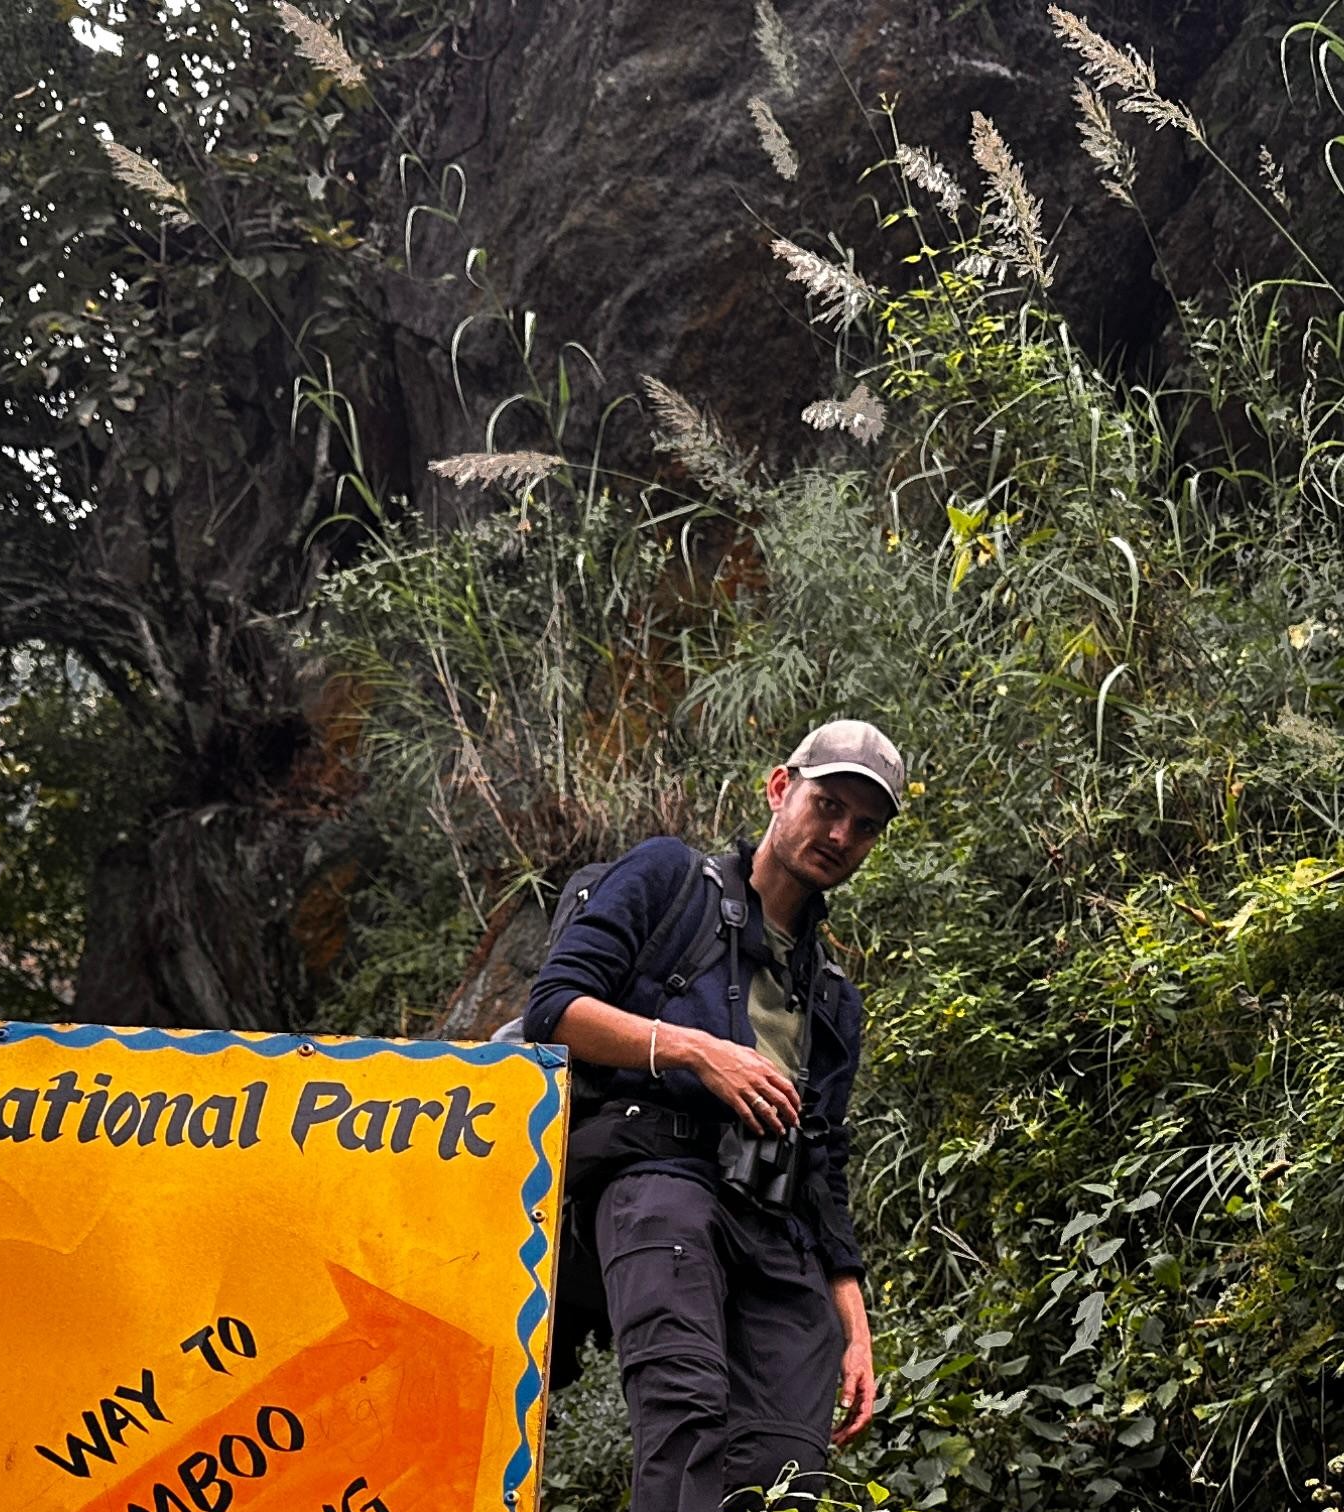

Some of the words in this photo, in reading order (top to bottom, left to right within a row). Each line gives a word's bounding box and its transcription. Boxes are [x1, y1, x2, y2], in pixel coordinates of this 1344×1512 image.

[290, 1080, 496, 1162] Park
[34, 1368, 173, 1479] WAY
[179, 1316, 258, 1375] TO
